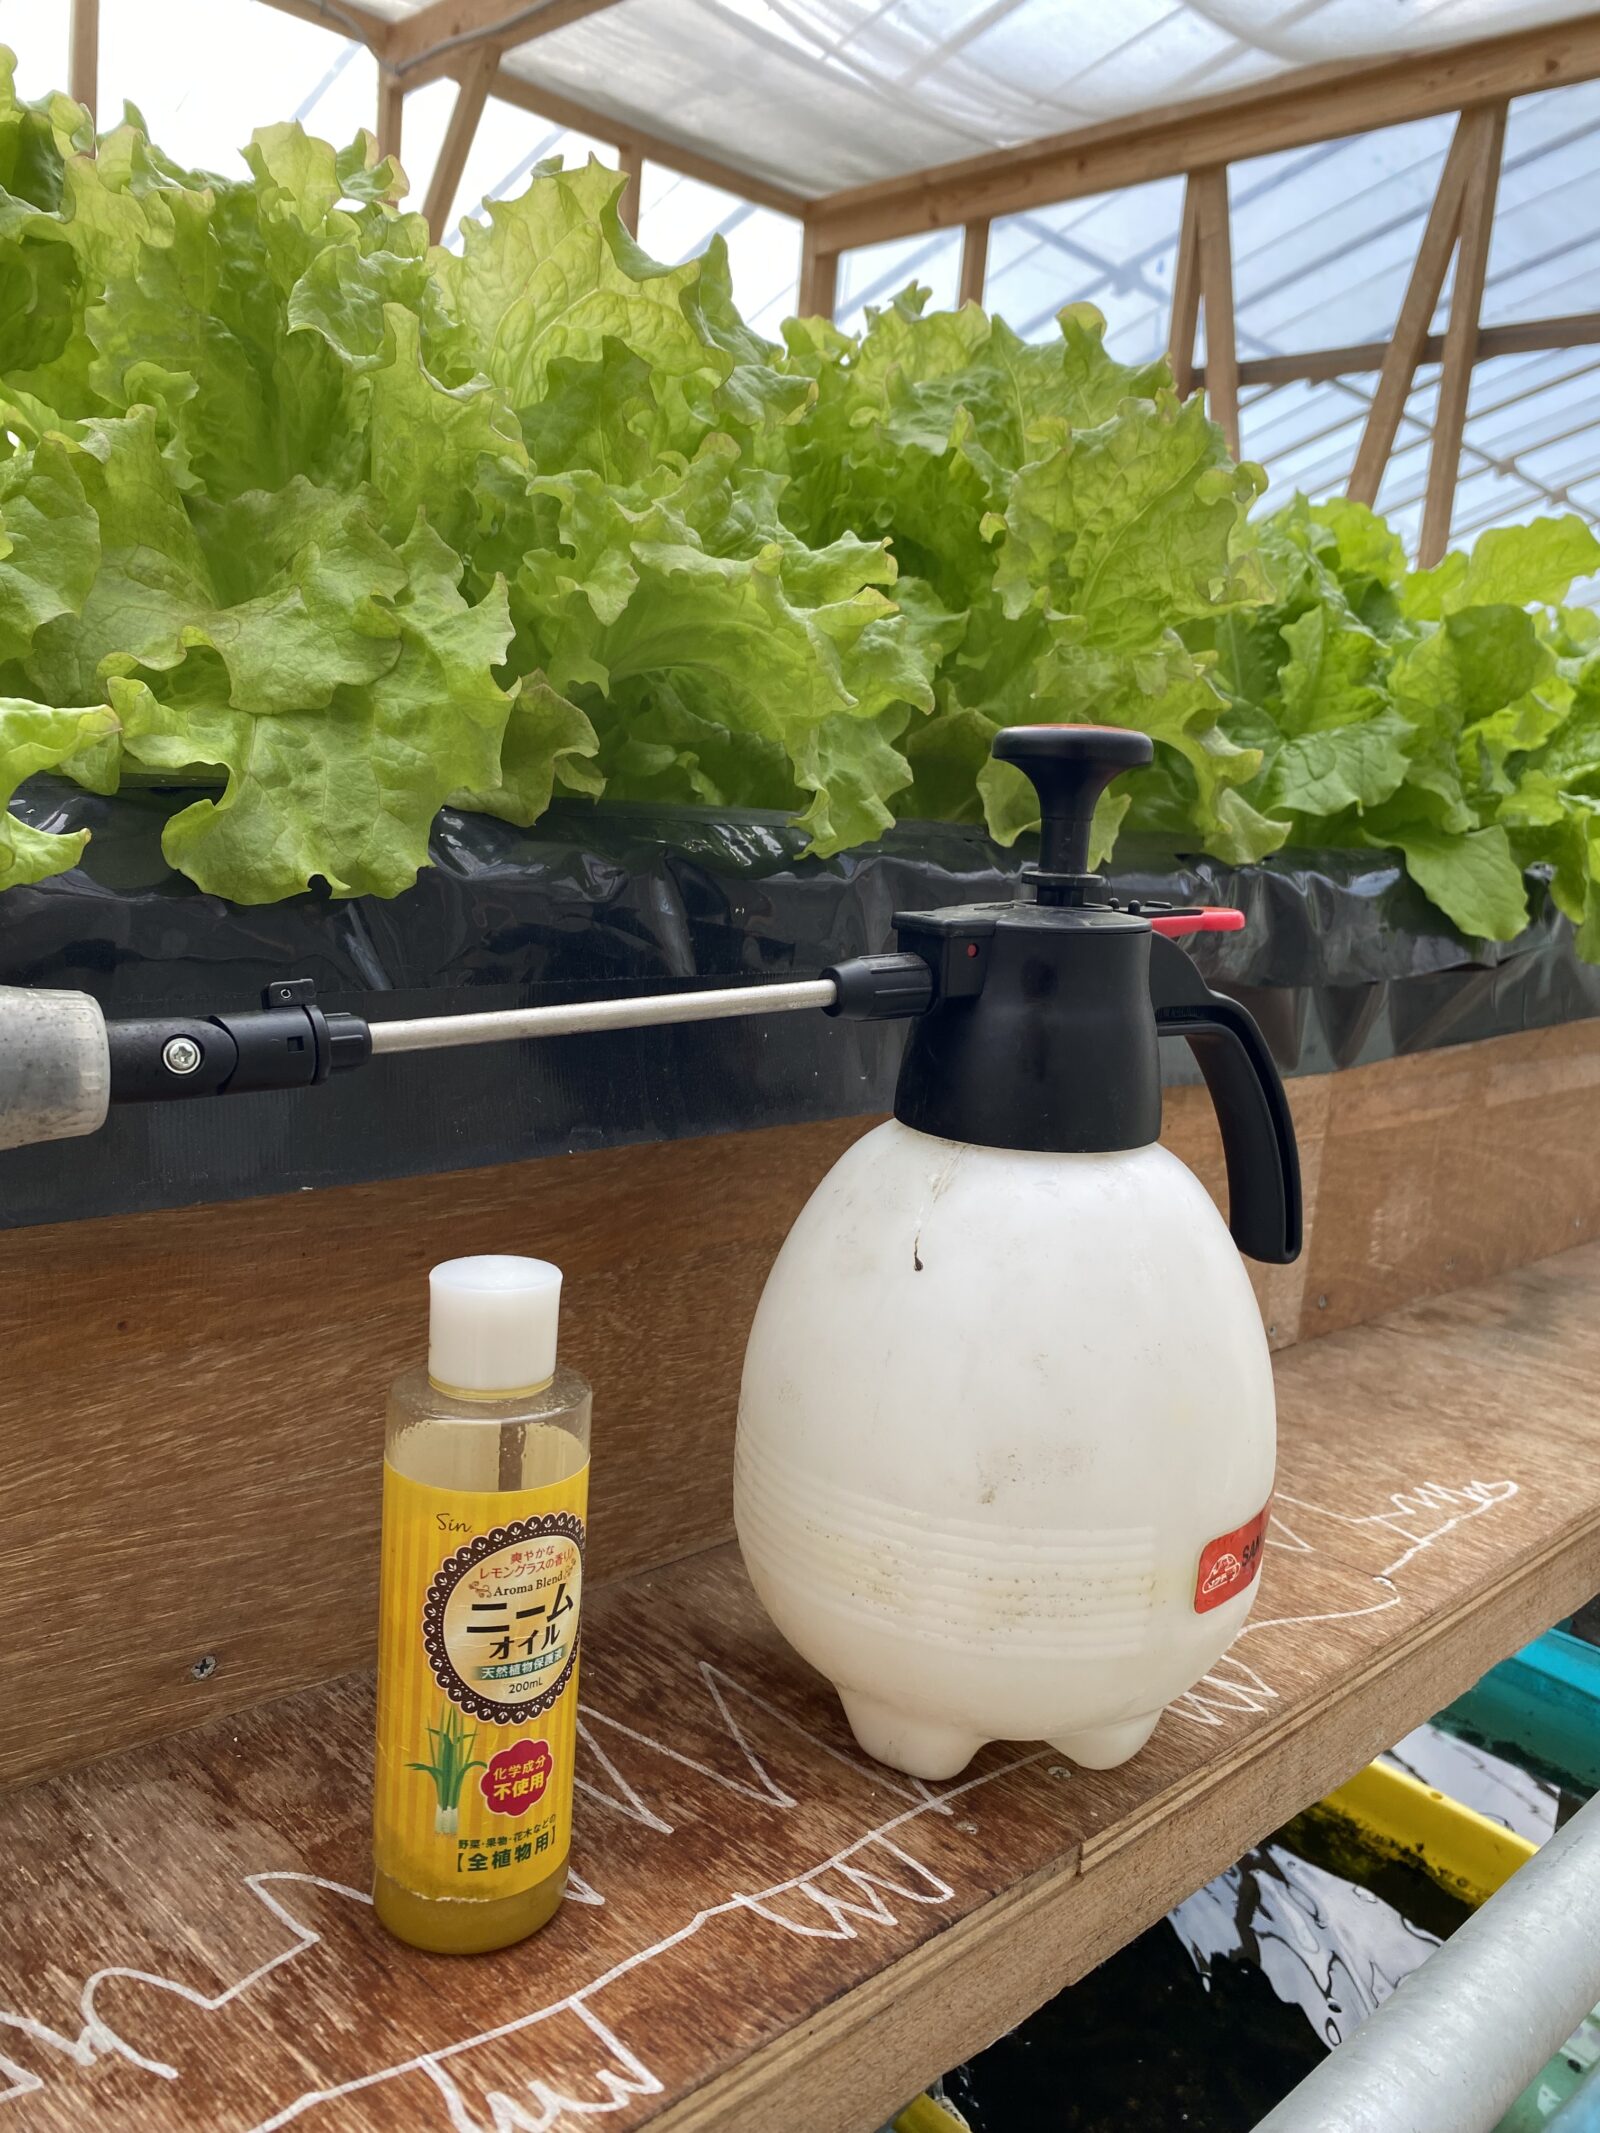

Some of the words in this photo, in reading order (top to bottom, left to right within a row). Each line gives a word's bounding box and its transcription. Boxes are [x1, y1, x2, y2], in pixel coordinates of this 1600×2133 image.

[480, 1547, 574, 1579] レモングラスの香り
[511, 1545, 555, 1564] 爽やかな
[493, 1584, 533, 1597] Aroma
[536, 1571, 564, 1590] Blend
[467, 1583, 574, 1633] ニーム
[489, 1623, 561, 1660] オイル
[481, 1648, 563, 1679] 天然植物保護液
[508, 1677, 544, 1694] 200mL
[494, 1754, 547, 1782] 化学成分
[493, 1771, 545, 1801] 不使用
